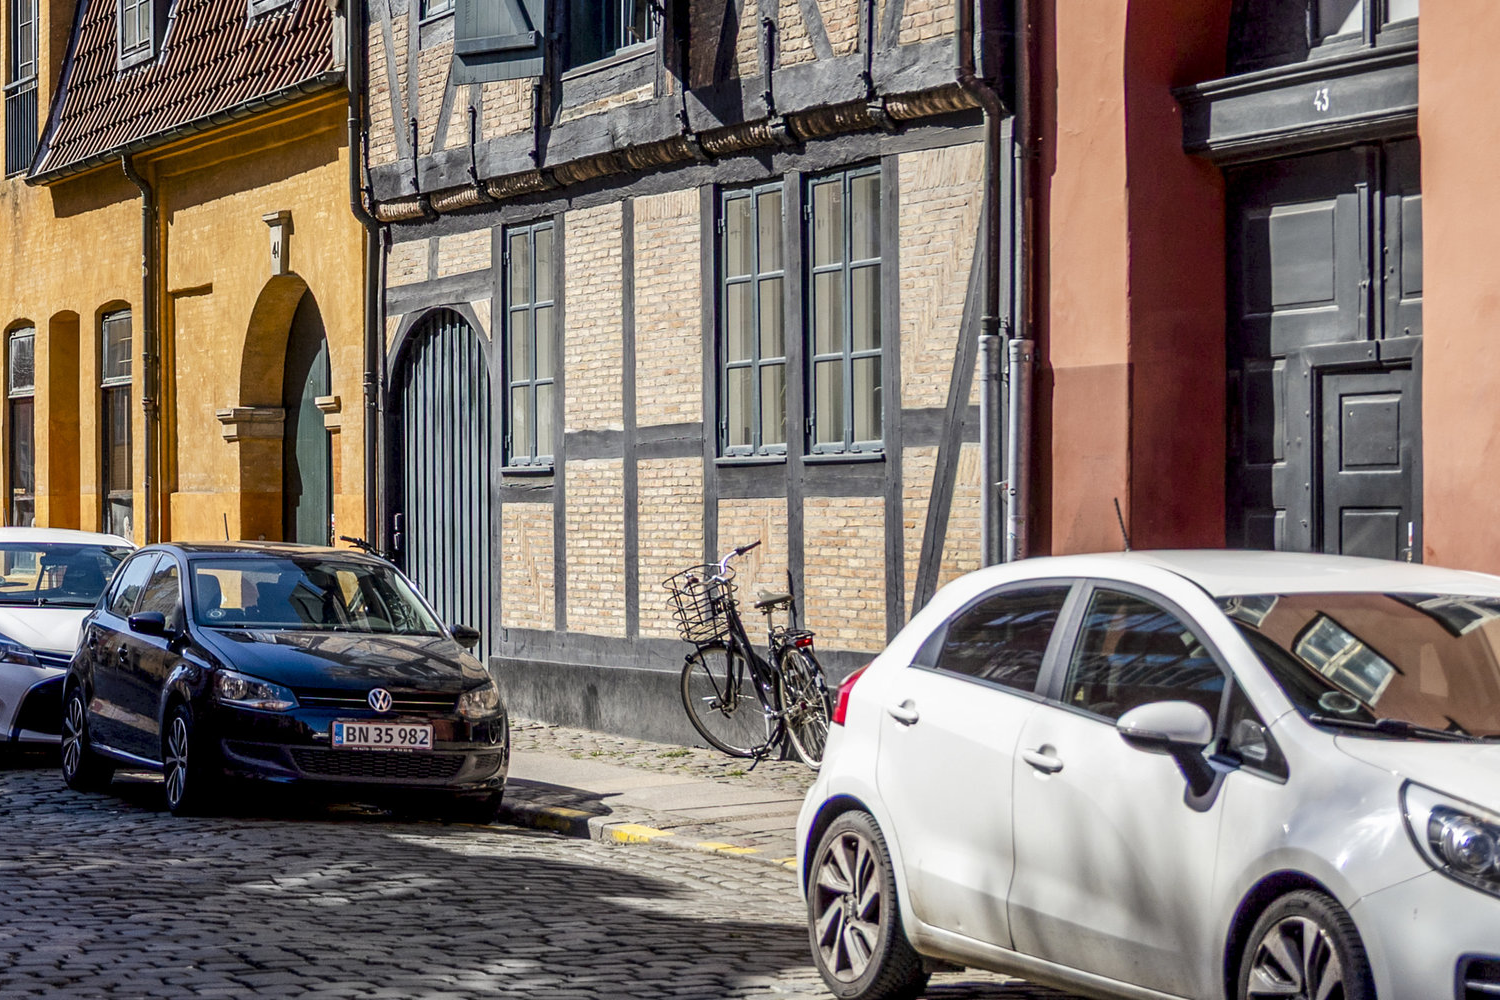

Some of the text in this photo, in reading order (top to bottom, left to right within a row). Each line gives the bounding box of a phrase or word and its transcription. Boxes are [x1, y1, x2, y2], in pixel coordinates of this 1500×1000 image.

[1313, 87, 1329, 111] 43
[271, 241, 279, 259] 41
[346, 726, 429, 745] BN 35 982
